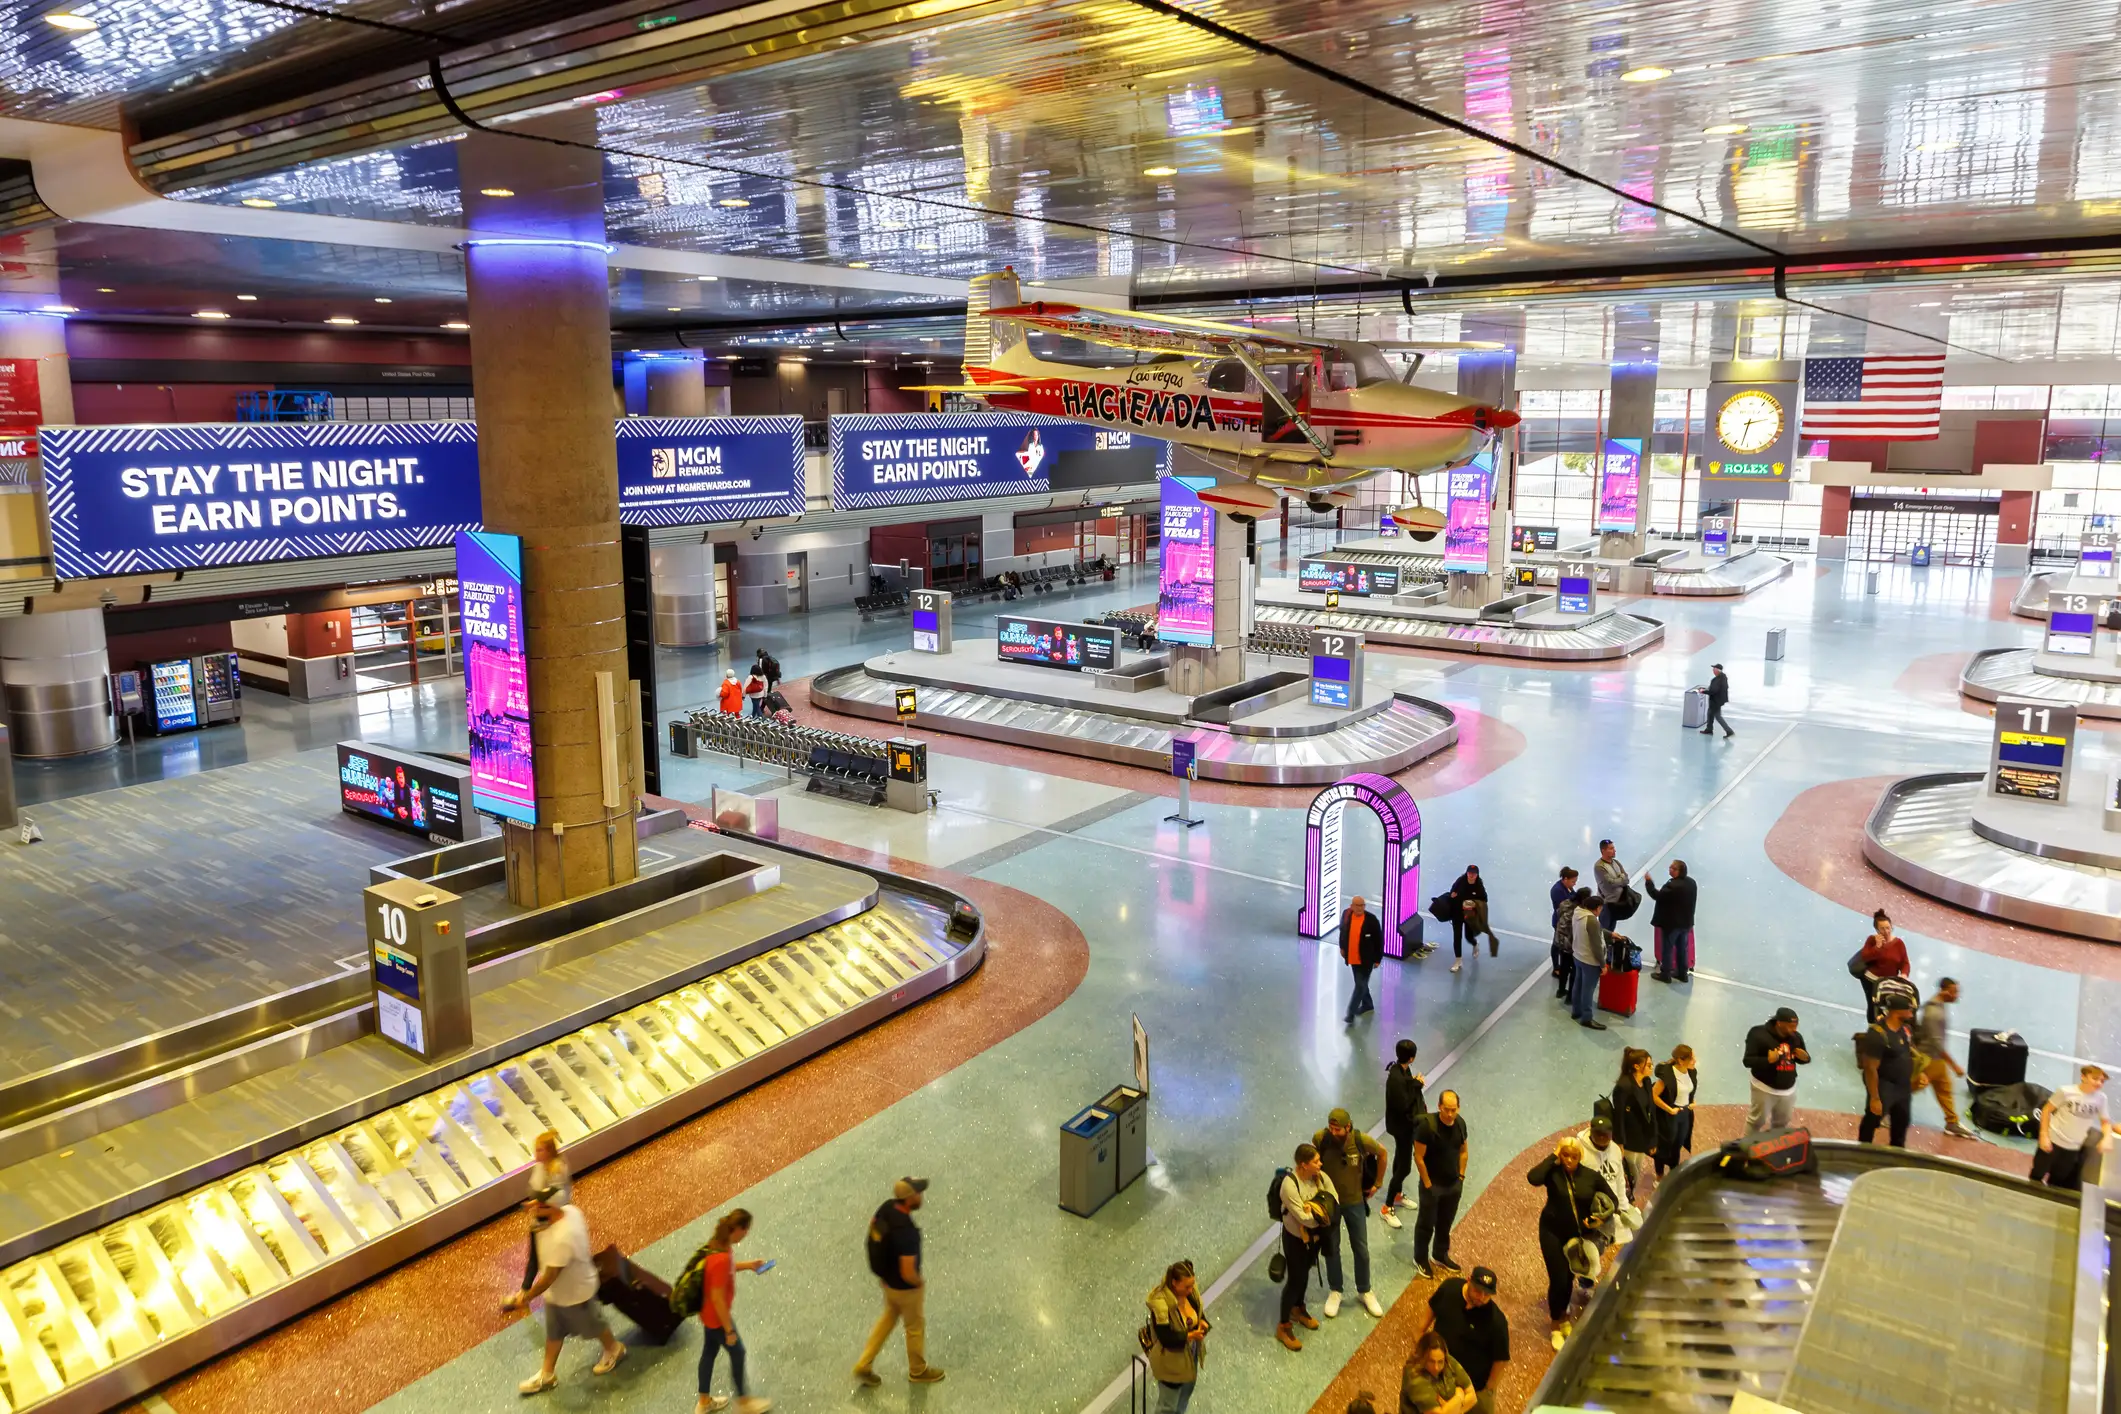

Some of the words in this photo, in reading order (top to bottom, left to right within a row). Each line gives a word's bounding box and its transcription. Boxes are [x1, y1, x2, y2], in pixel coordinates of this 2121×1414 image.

[1126, 367, 1150, 385] Las
[1152, 365, 1184, 389] Vegas
[1108, 431, 1130, 445] MGM
[678, 446, 721, 466] MGM
[861, 440, 903, 461] STAY
[906, 438, 938, 458] THE
[941, 437, 990, 457] NIGHT.
[679, 465, 724, 477] REWARDS.
[873, 462, 919, 484] EARN
[922, 459, 982, 481] POINTS.
[1724, 463, 1769, 474] ROLEX
[121, 465, 221, 498] STAY
[228, 461, 304, 493] THE
[312, 457, 424, 489] NIGHT.
[623, 486, 644, 496] JOIN
[645, 484, 665, 495] NOW
[665, 483, 676, 494] AT
[676, 479, 751, 493] MGMREWARDS.COM
[152, 499, 262, 535] EARN
[270, 492, 407, 527] POINTS.
[1893, 502, 1904, 510] 14
[1164, 517, 1187, 527] LAS
[1710, 519, 1724, 530] 16
[1164, 527, 1200, 539] VEGAS
[2090, 534, 2109, 546] 15
[1567, 563, 1584, 577] 14
[420, 583, 436, 596] 12
[463, 581, 495, 594] WELCOME
[495, 585, 505, 595] TO
[463, 590, 496, 604] FABULOUS
[917, 594, 933, 610] 12
[2062, 595, 2088, 612] 13
[464, 600, 490, 619] LAS
[464, 619, 508, 640] VEGAS
[1000, 631, 1036, 645] DUNHAM
[1322, 636, 1344, 656] 12
[172, 716, 192, 726] pepsi
[2018, 707, 2050, 733] 11
[348, 754, 369, 772] JEFF
[341, 766, 379, 792] DUNHAM
[1356, 786, 1373, 803] ONLY
[1370, 795, 1395, 824] HAPPENS
[1386, 823, 1400, 841] HERE
[509, 818, 532, 829] LAMAR
[1324, 806, 1342, 876] HAPPENS
[1323, 879, 1337, 925] WHAT
[378, 903, 407, 945] 10
